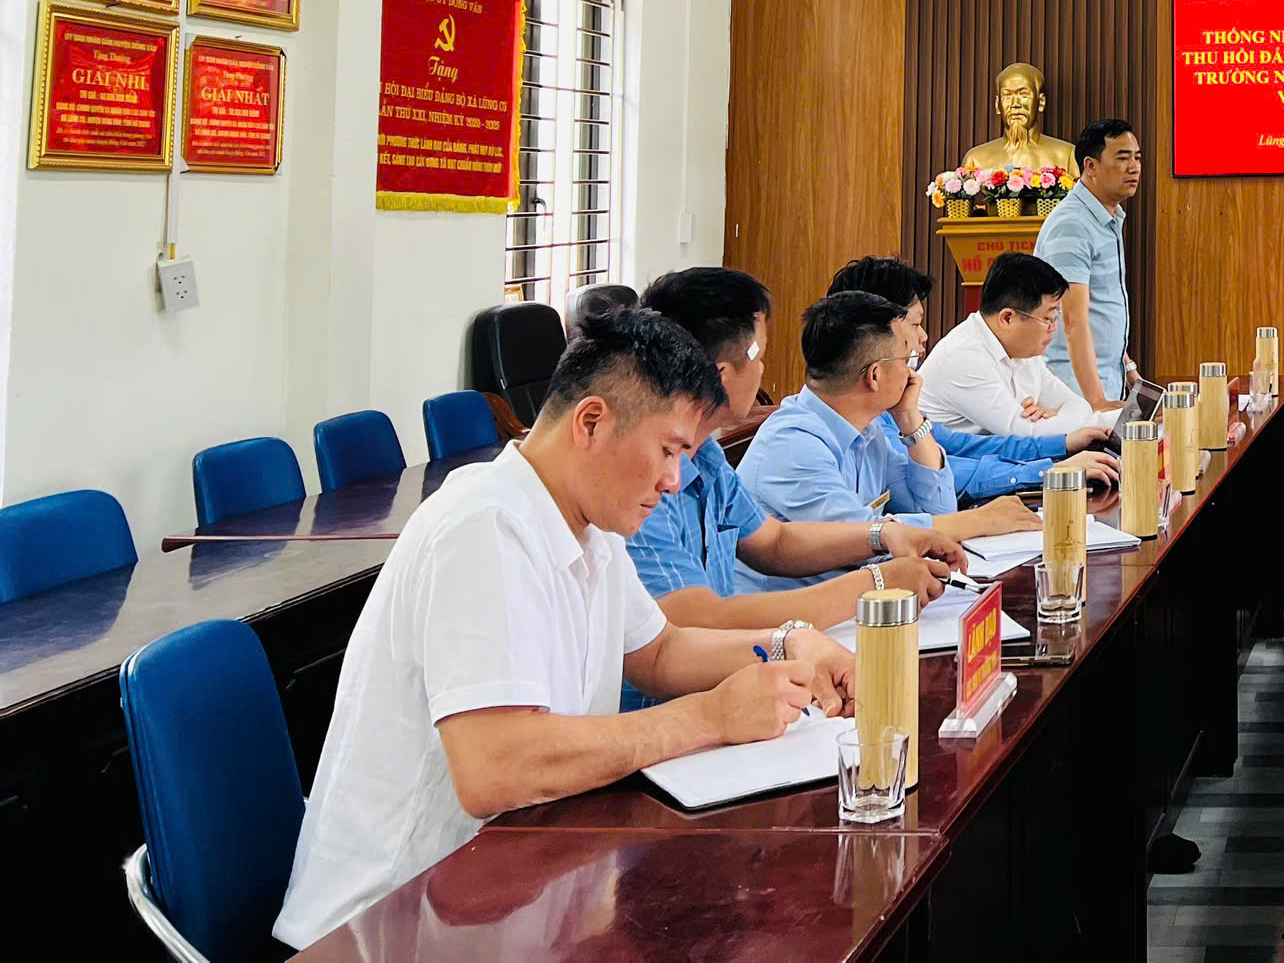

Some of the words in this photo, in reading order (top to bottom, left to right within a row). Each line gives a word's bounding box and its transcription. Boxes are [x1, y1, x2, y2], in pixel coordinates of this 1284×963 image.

[1202, 26, 1265, 45] THỐNG
[1182, 51, 1218, 65] THU
[1223, 48, 1255, 64] HỒI
[427, 55, 459, 83] Tặng
[1194, 68, 1269, 85] TRƯỜNG
[235, 86, 270, 106] NHẤT
